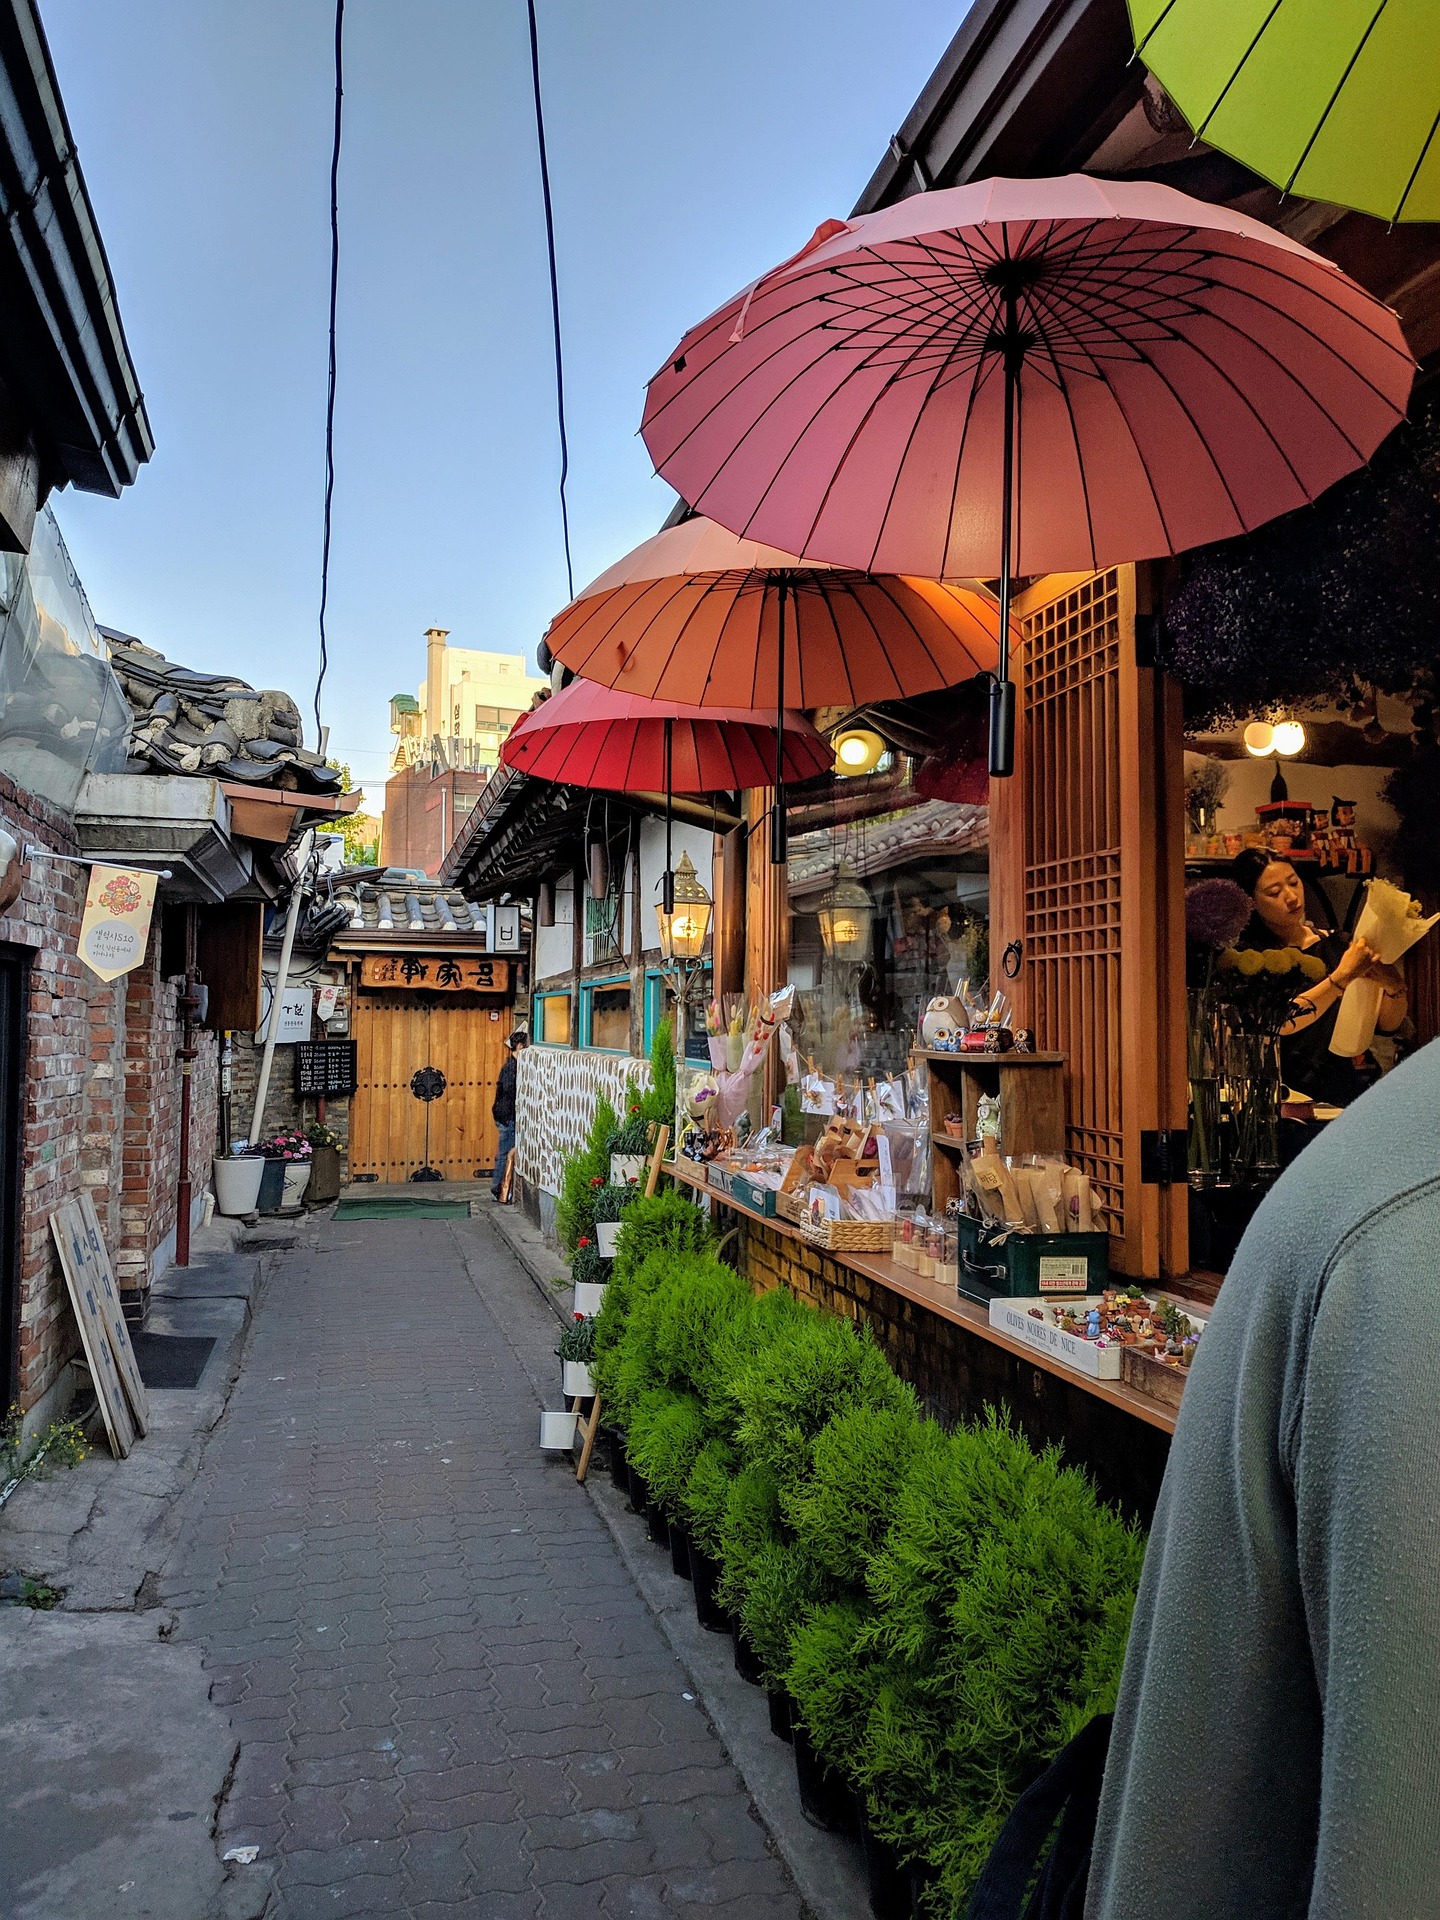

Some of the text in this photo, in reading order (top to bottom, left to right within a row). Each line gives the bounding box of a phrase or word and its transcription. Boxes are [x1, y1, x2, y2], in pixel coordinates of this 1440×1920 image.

[95, 930, 134, 943] 갤럭시S10
[1006, 1311, 1025, 1330] OLIVES
[1027, 1321, 1047, 1341] NOIRES
[1049, 1331, 1058, 1347] DE
[1061, 1336, 1076, 1355] NICE
